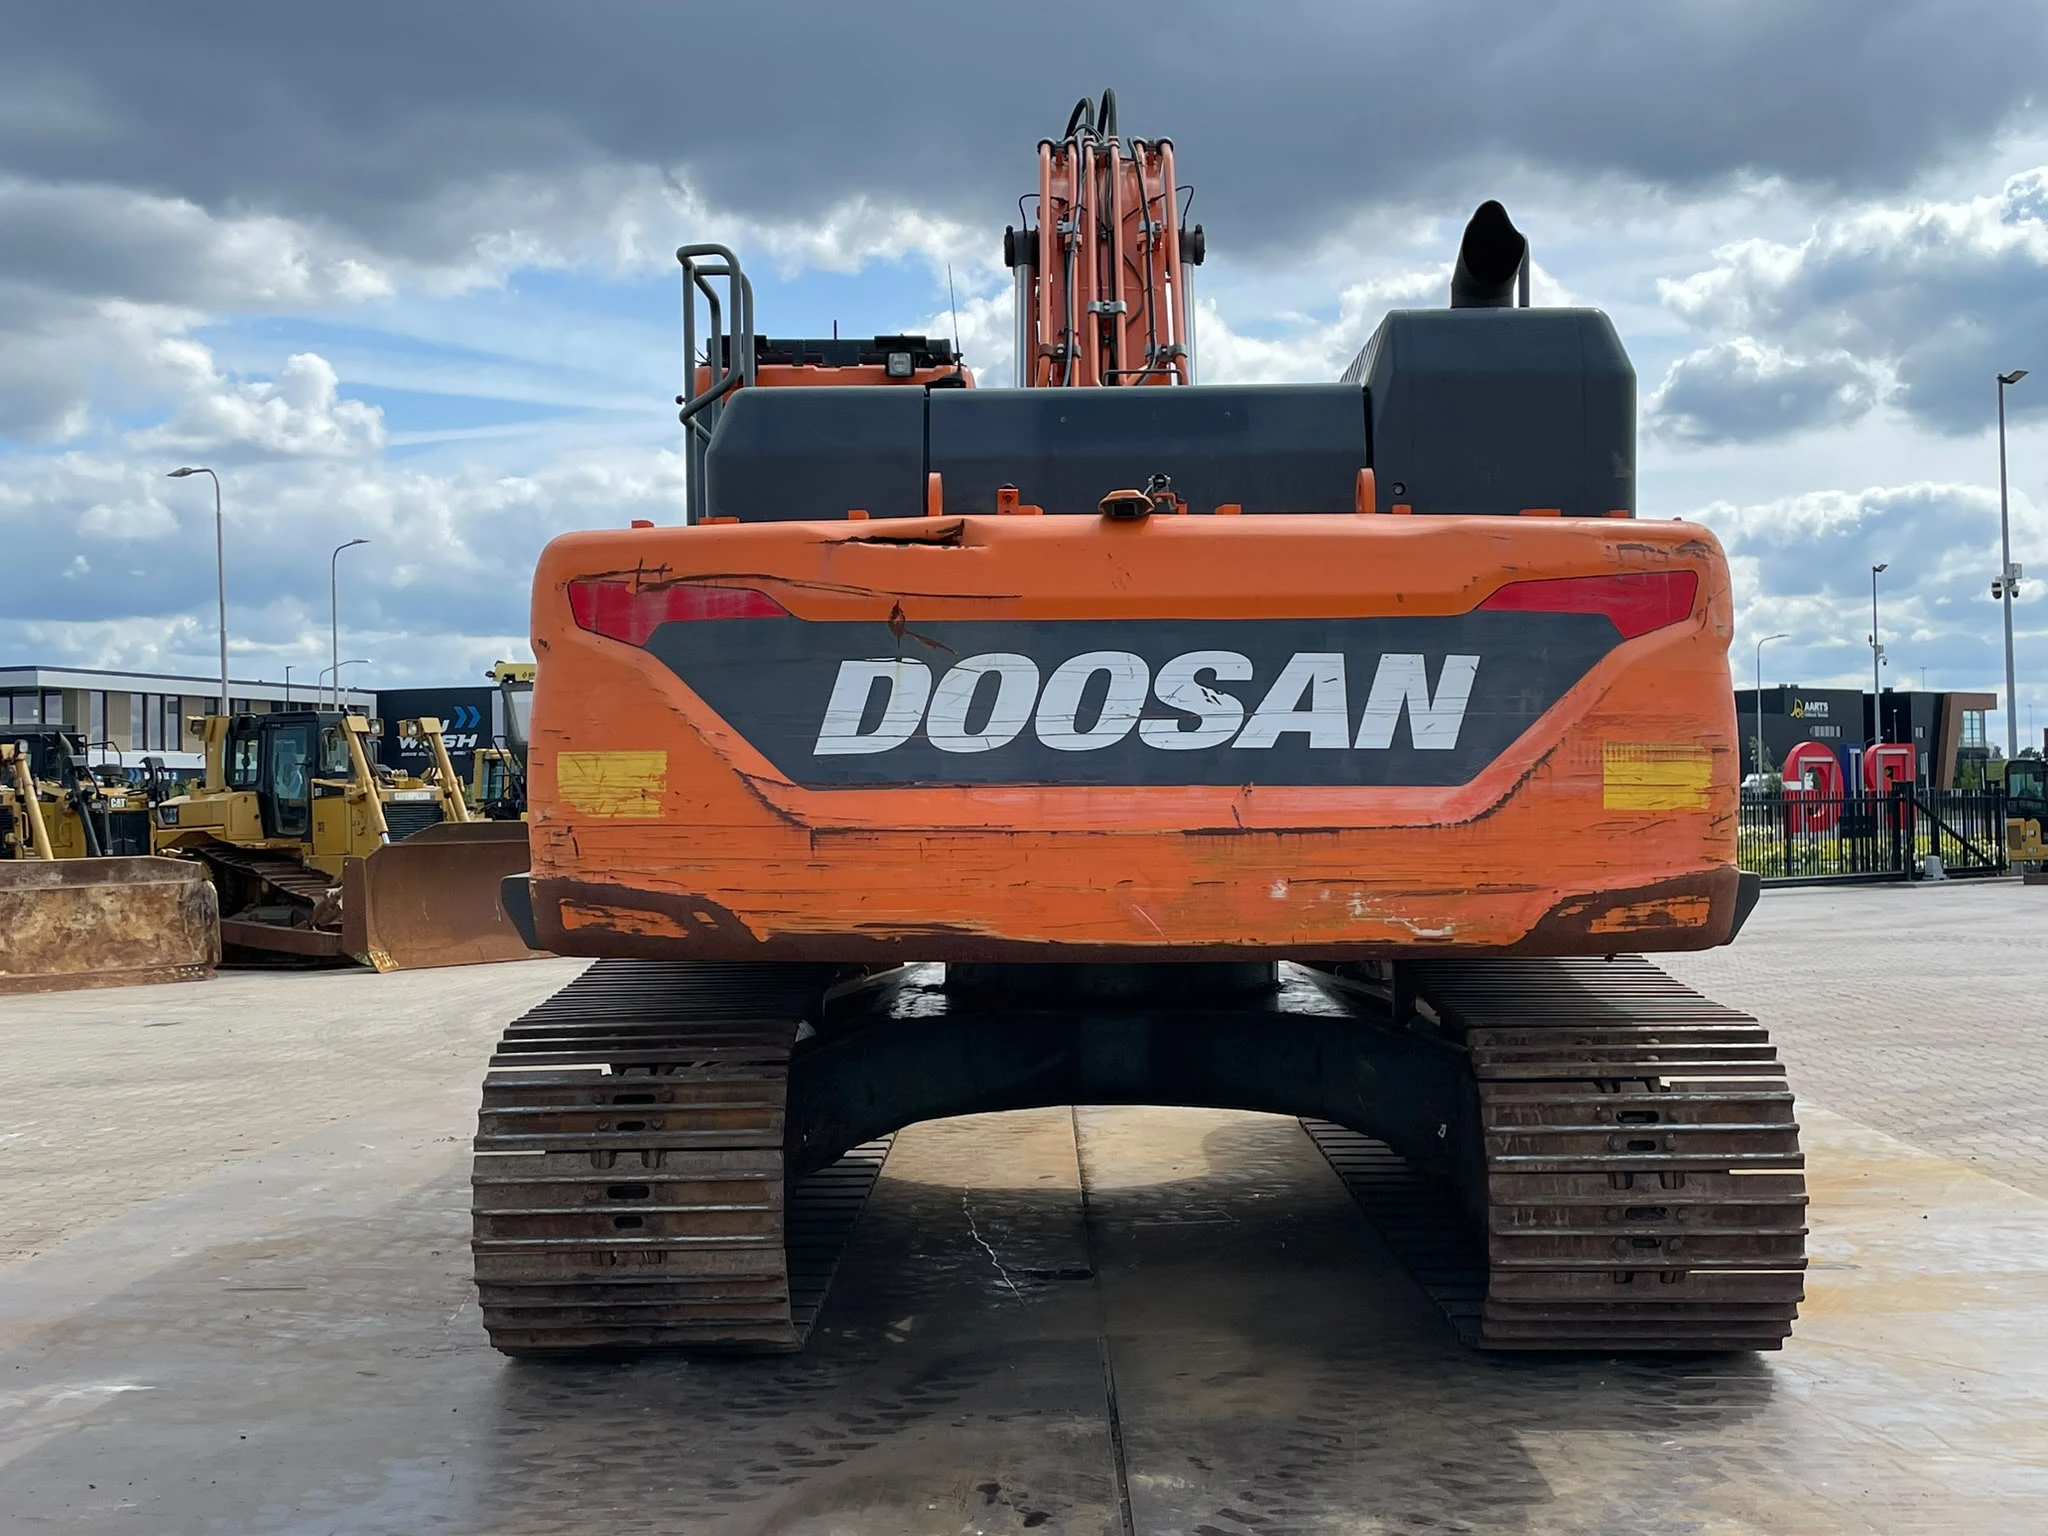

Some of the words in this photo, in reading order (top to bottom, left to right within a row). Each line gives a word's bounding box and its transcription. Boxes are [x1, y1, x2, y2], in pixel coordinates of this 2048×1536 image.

[813, 651, 1480, 755] DOOSAN
[1804, 701, 1829, 712] AARTS
[110, 798, 126, 808] CAT
